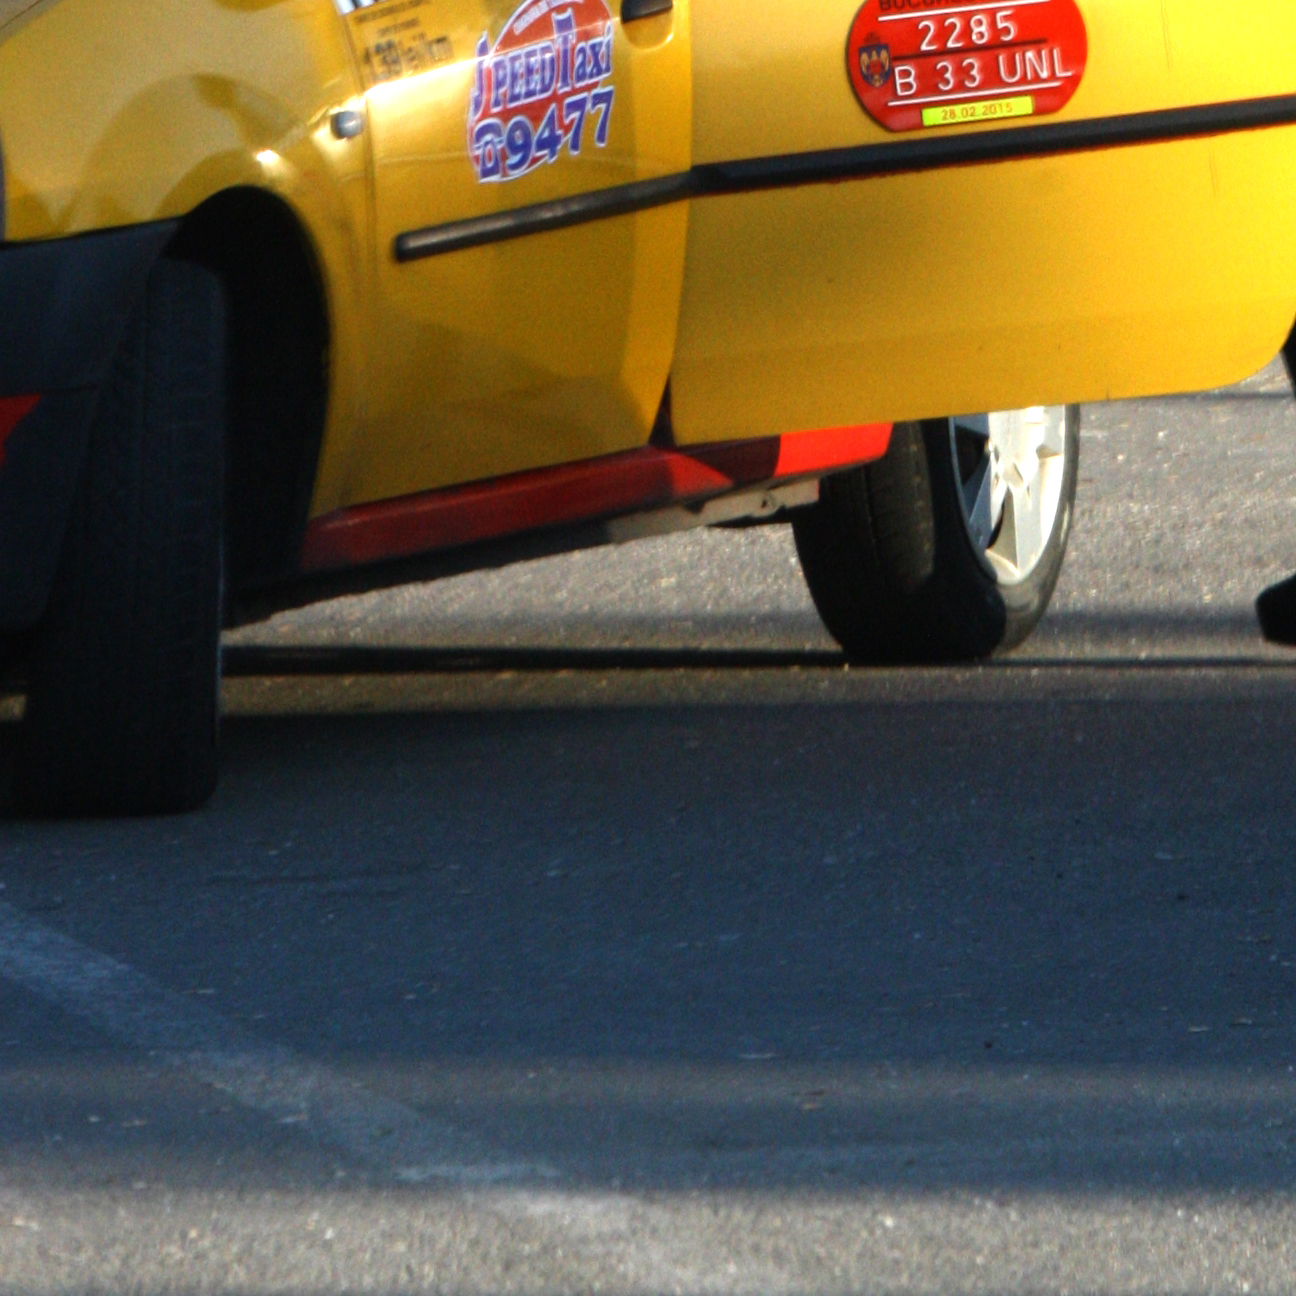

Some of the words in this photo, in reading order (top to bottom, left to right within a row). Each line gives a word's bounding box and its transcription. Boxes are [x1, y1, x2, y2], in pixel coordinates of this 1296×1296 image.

[917, 9, 1015, 51] 2285
[894, 65, 917, 96] B
[936, 58, 981, 91] 33
[998, 47, 1073, 83] UNL
[505, 86, 614, 176] 9477
